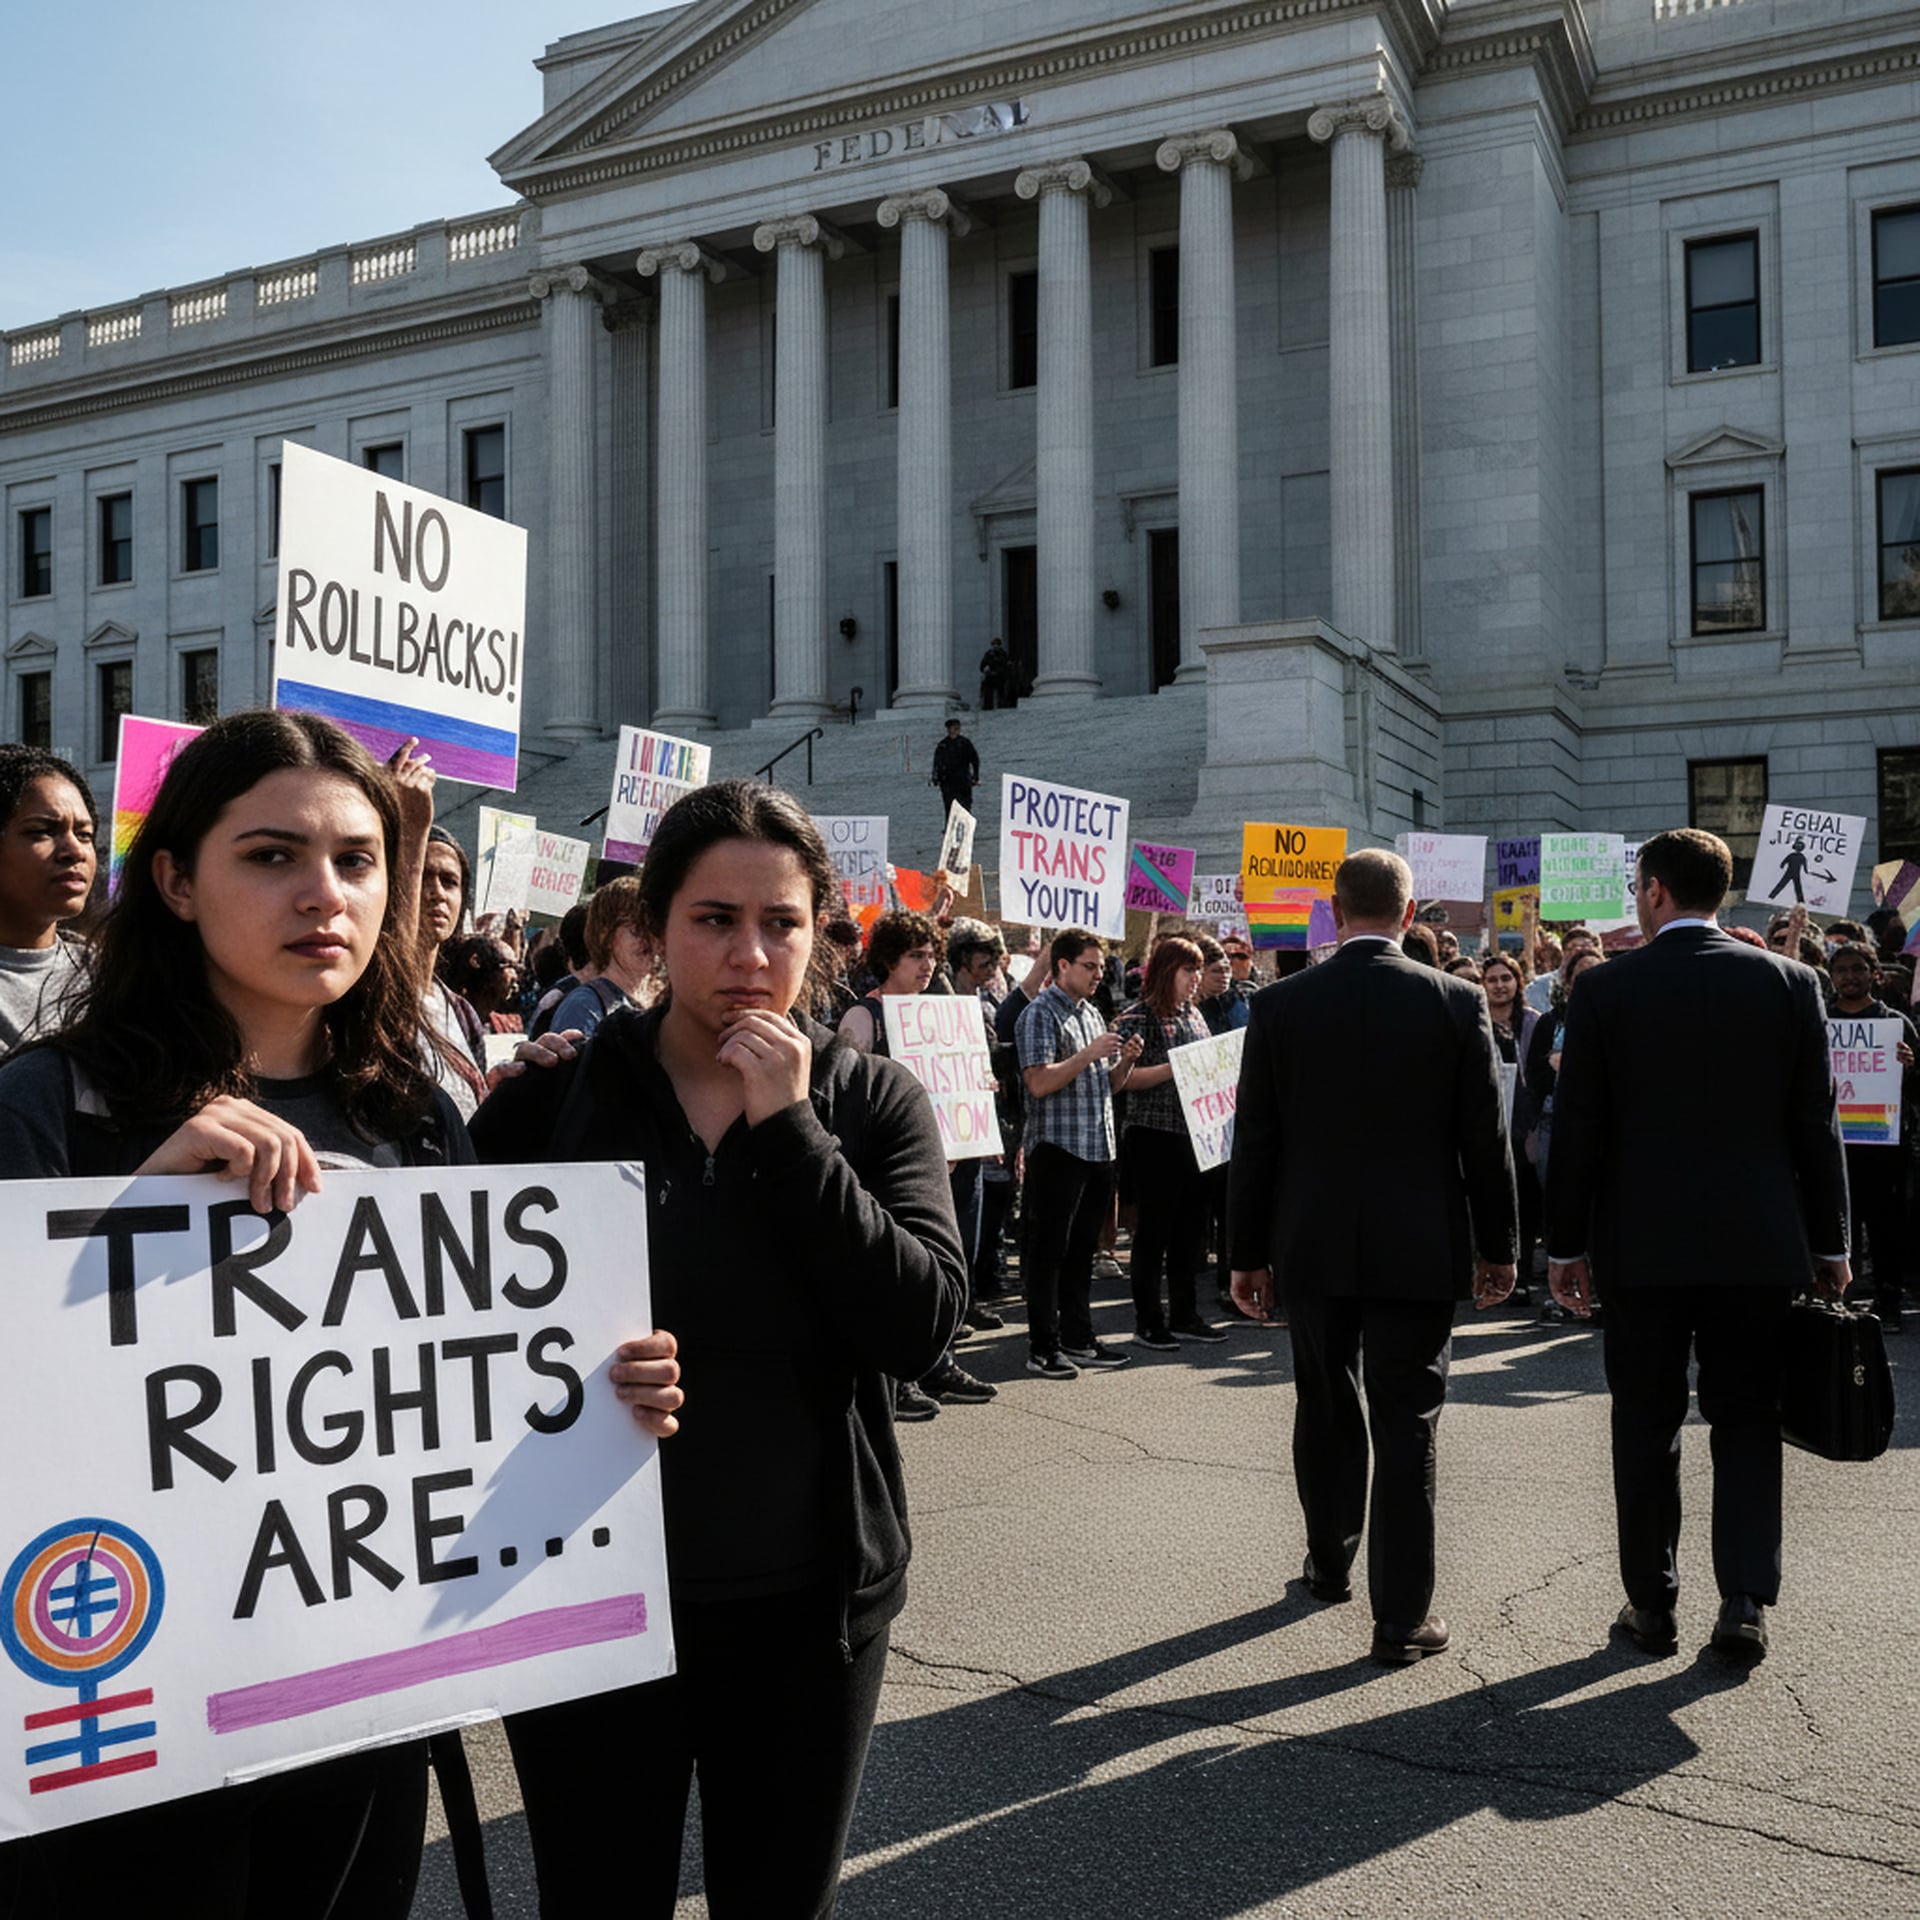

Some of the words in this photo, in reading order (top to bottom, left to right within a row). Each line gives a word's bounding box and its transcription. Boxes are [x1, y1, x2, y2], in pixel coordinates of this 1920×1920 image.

[374, 490, 451, 593] NO
[286, 568, 518, 703] ROLLBACKS!
[1010, 782, 1121, 840] PROTECT
[1275, 829, 1306, 855] NO
[1010, 829, 1107, 885] TRANS
[1020, 877, 1099, 927] YOUTH
[47, 1186, 568, 1346] TRANS
[145, 1327, 585, 1491] RIGHTS
